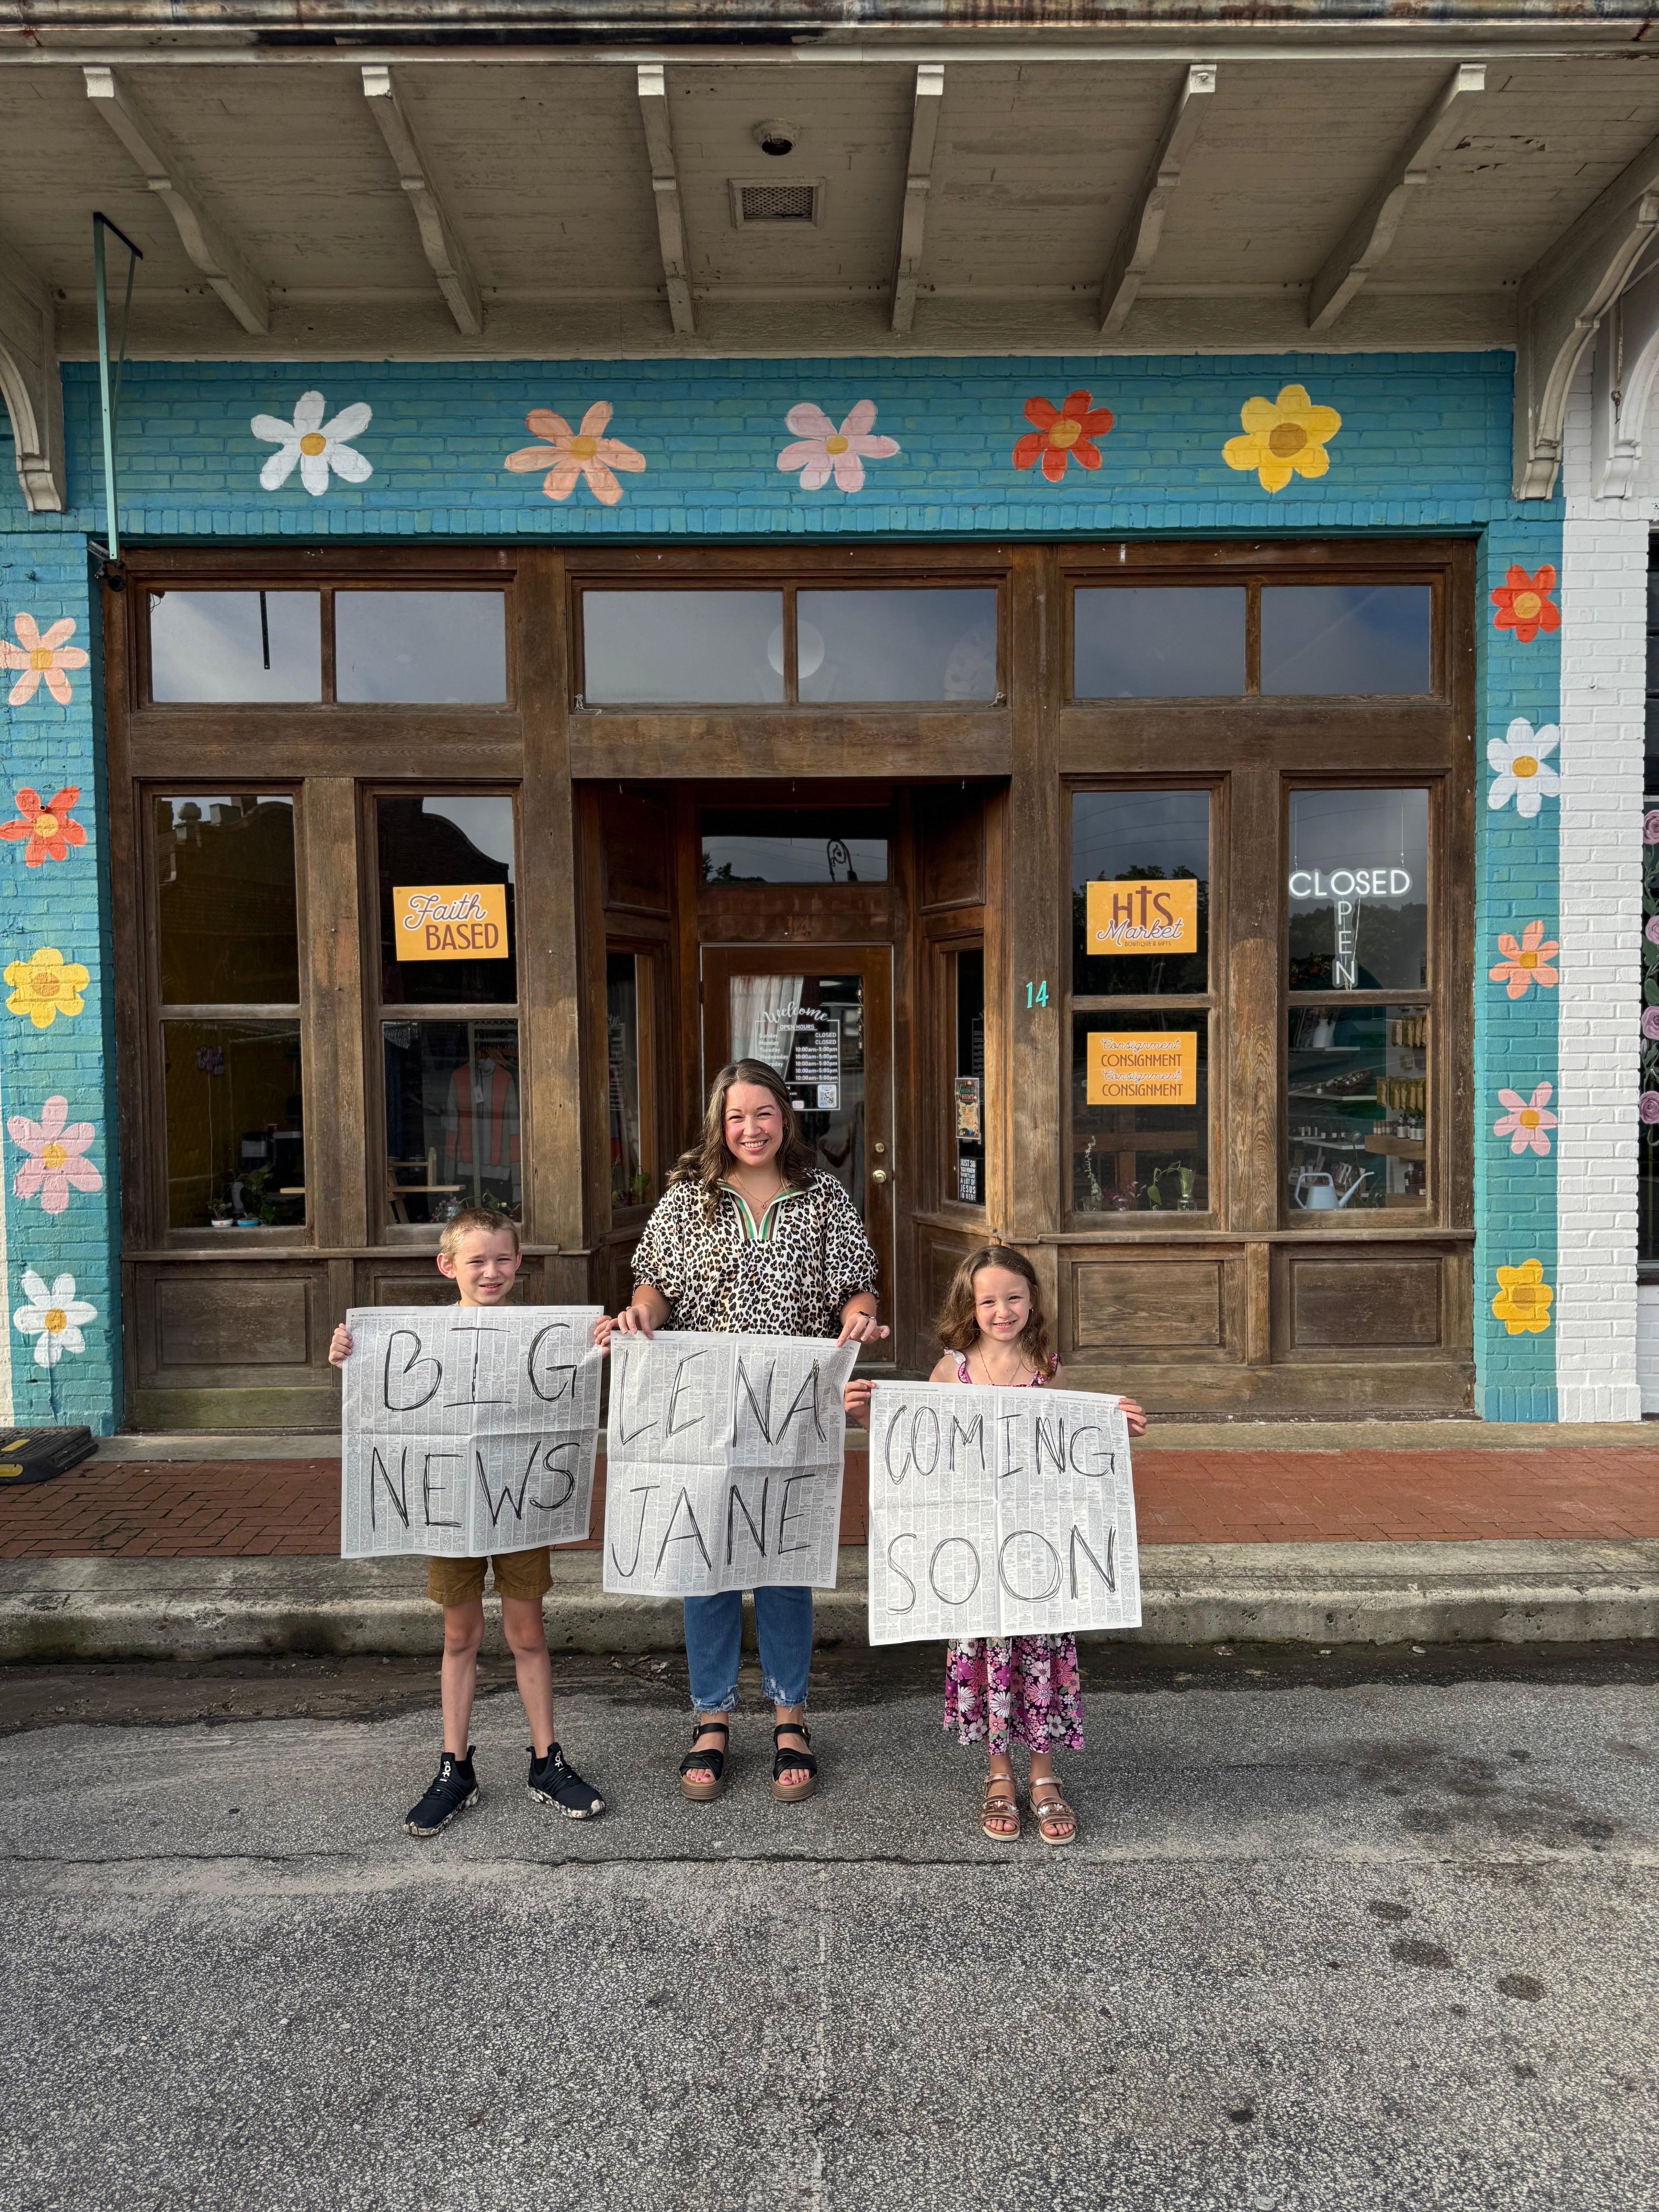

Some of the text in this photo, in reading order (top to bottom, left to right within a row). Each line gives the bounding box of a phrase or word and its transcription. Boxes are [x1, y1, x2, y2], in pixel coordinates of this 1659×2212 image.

[1289, 870, 1410, 896] CLOSED
[404, 893, 486, 930] Faith
[426, 923, 499, 950] BASED
[1097, 918, 1183, 945] Market
[1026, 980, 1049, 1008] 14
[763, 1001, 828, 1023] Welcome
[1101, 1037, 1181, 1052] Consignment
[1101, 1054, 1182, 1067] CONSIGNMENT
[1103, 1068, 1182, 1084] Consignment
[1102, 1084, 1183, 1096] CONSIGNMENT
[960, 1159, 969, 1167] JUST
[960, 1184, 976, 1194] JESUS
[383, 1322, 577, 1412] BIG
[619, 1349, 827, 1448] LENA
[885, 1404, 1115, 1485] COMING
[371, 1440, 580, 1532] NEWS
[611, 1473, 817, 1579] JANE
[885, 1525, 1117, 1615] SOON
